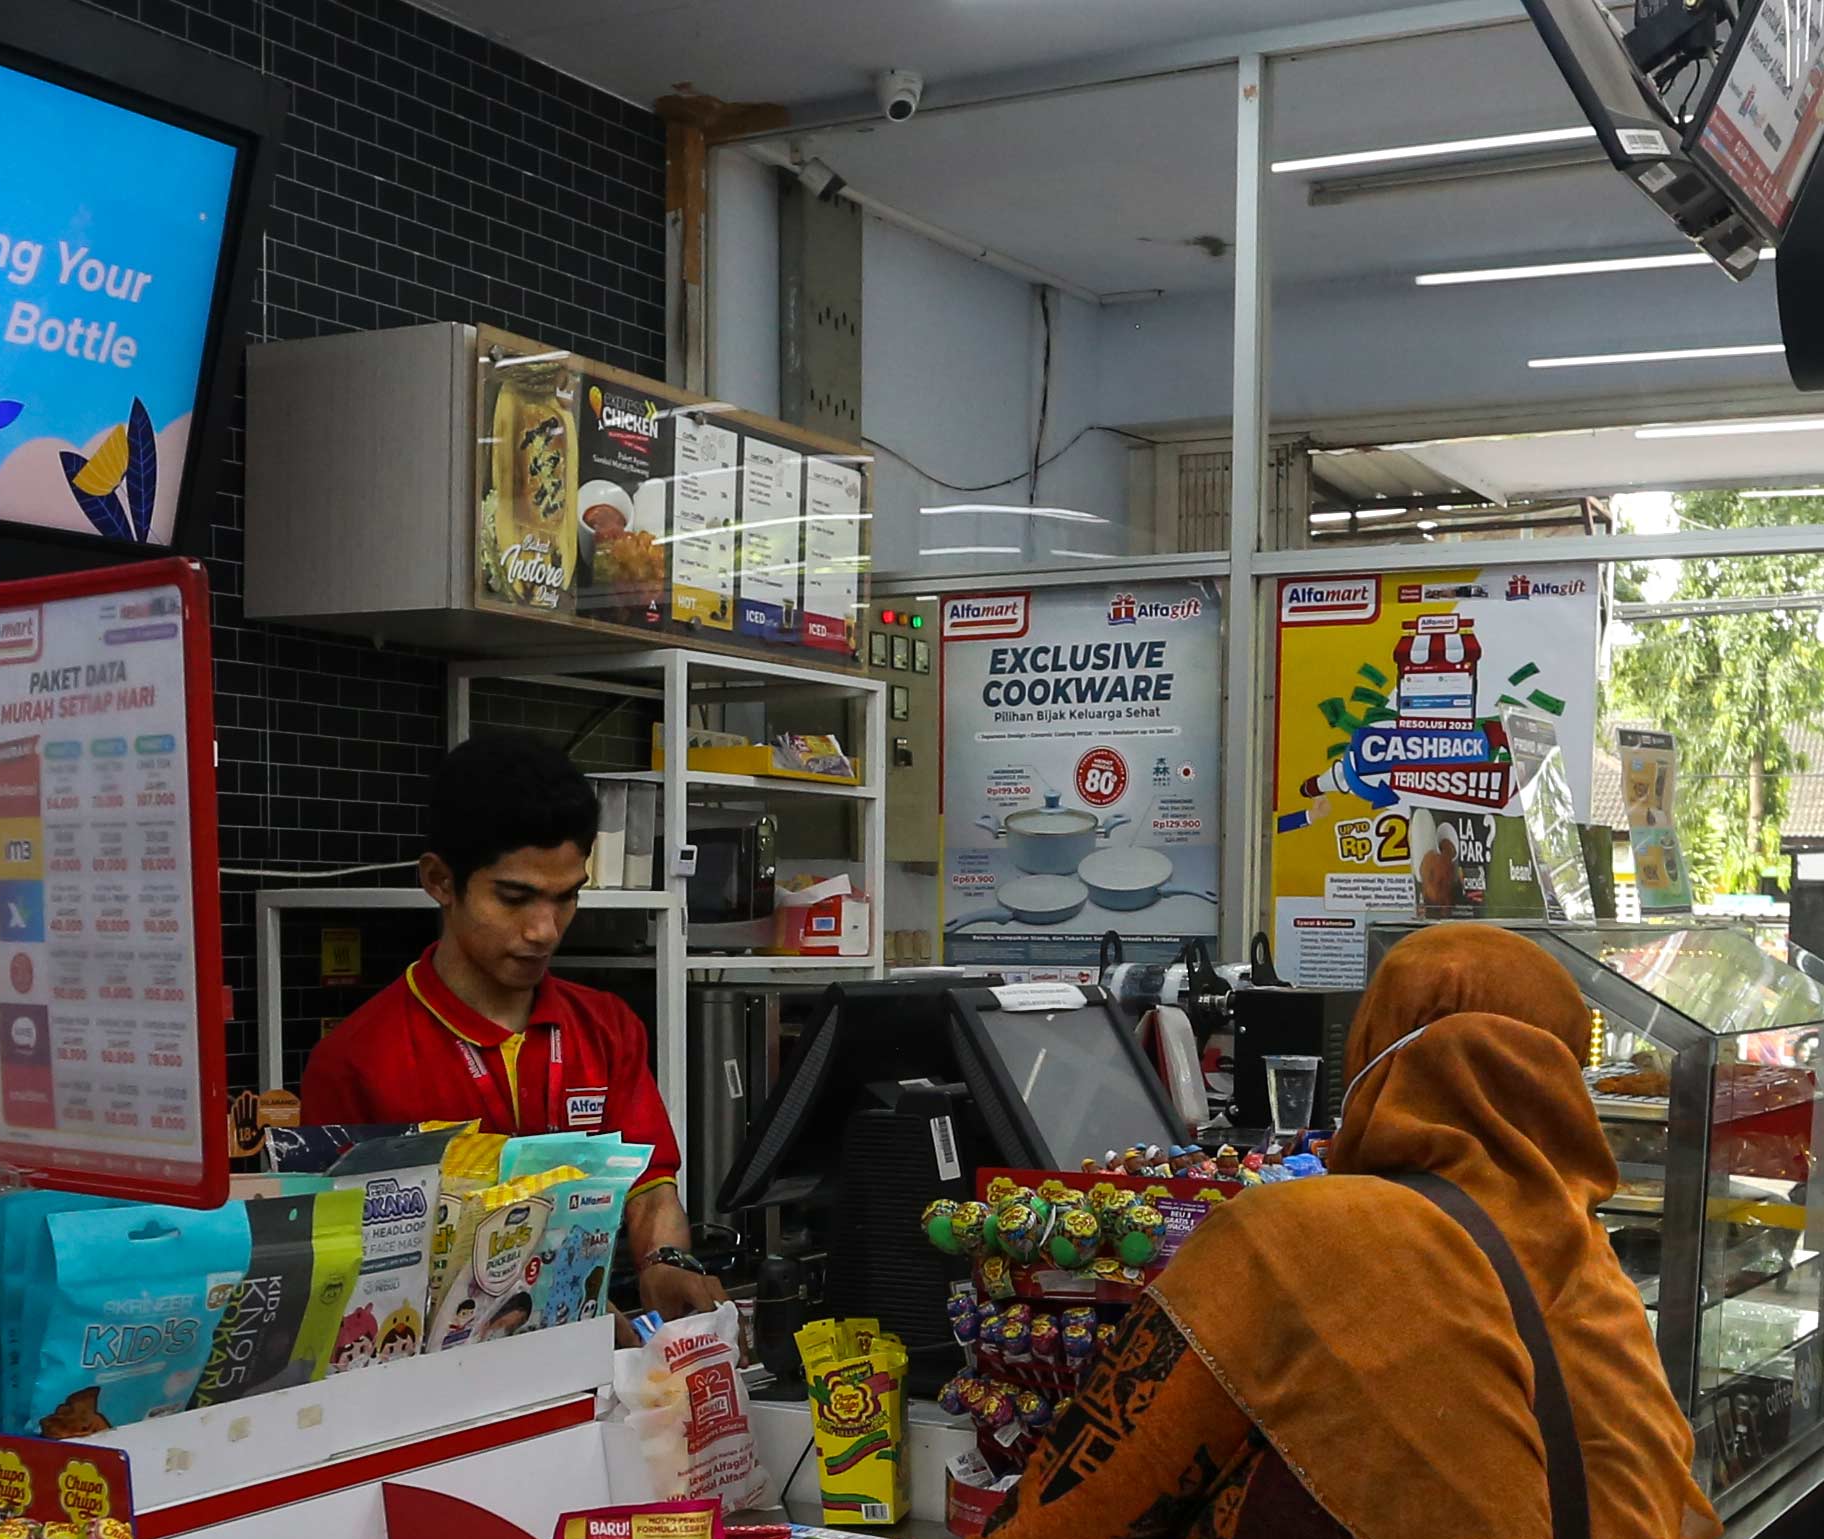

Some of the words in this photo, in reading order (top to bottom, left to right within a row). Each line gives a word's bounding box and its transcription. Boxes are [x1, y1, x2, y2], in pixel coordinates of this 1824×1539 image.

[57, 240, 153, 307] Your
[5, 302, 138, 371] Bottle
[602, 406, 659, 439] CHICKEN
[501, 545, 564, 587] Instore
[1289, 585, 1369, 604] Alfamart
[1531, 578, 1587, 596] Alfagift
[678, 596, 697, 610] HOT
[950, 601, 1018, 621] Alfamart
[1138, 599, 1201, 619] Alfagift
[746, 609, 766, 625] ICED
[1420, 617, 1456, 628] Alfamart
[809, 622, 828, 637] ICED
[989, 640, 1166, 675] EXCLUSIVE
[29, 667, 81, 694] PAKET
[86, 661, 127, 687] DATA
[982, 673, 1174, 707] COOKWARE
[0, 699, 54, 725] MURAH
[60, 692, 112, 717] SETIAP
[116, 685, 155, 710] HARI
[994, 710, 1034, 722] Pilihan
[1036, 710, 1066, 722] Bijak
[1069, 708, 1122, 721] Keluarga
[1125, 706, 1161, 719] Sehat
[1398, 720, 1447, 729] RESOLUSI
[1449, 721, 1473, 731] 2023
[1361, 735, 1484, 762] CASHBACK
[1394, 770, 1504, 799] TERUSSS!!!
[1153, 820, 1200, 829] Rp129.900
[1459, 818, 1474, 840] LA
[1340, 837, 1372, 859] Rp
[263, 1275, 282, 1323] KIDS
[216, 1277, 267, 1385] KN95
[81, 1318, 199, 1368] KID'S
[65, 1474, 105, 1495] Chupa
[63, 1488, 110, 1519] Chups
[590, 1521, 631, 1536] BARU!
